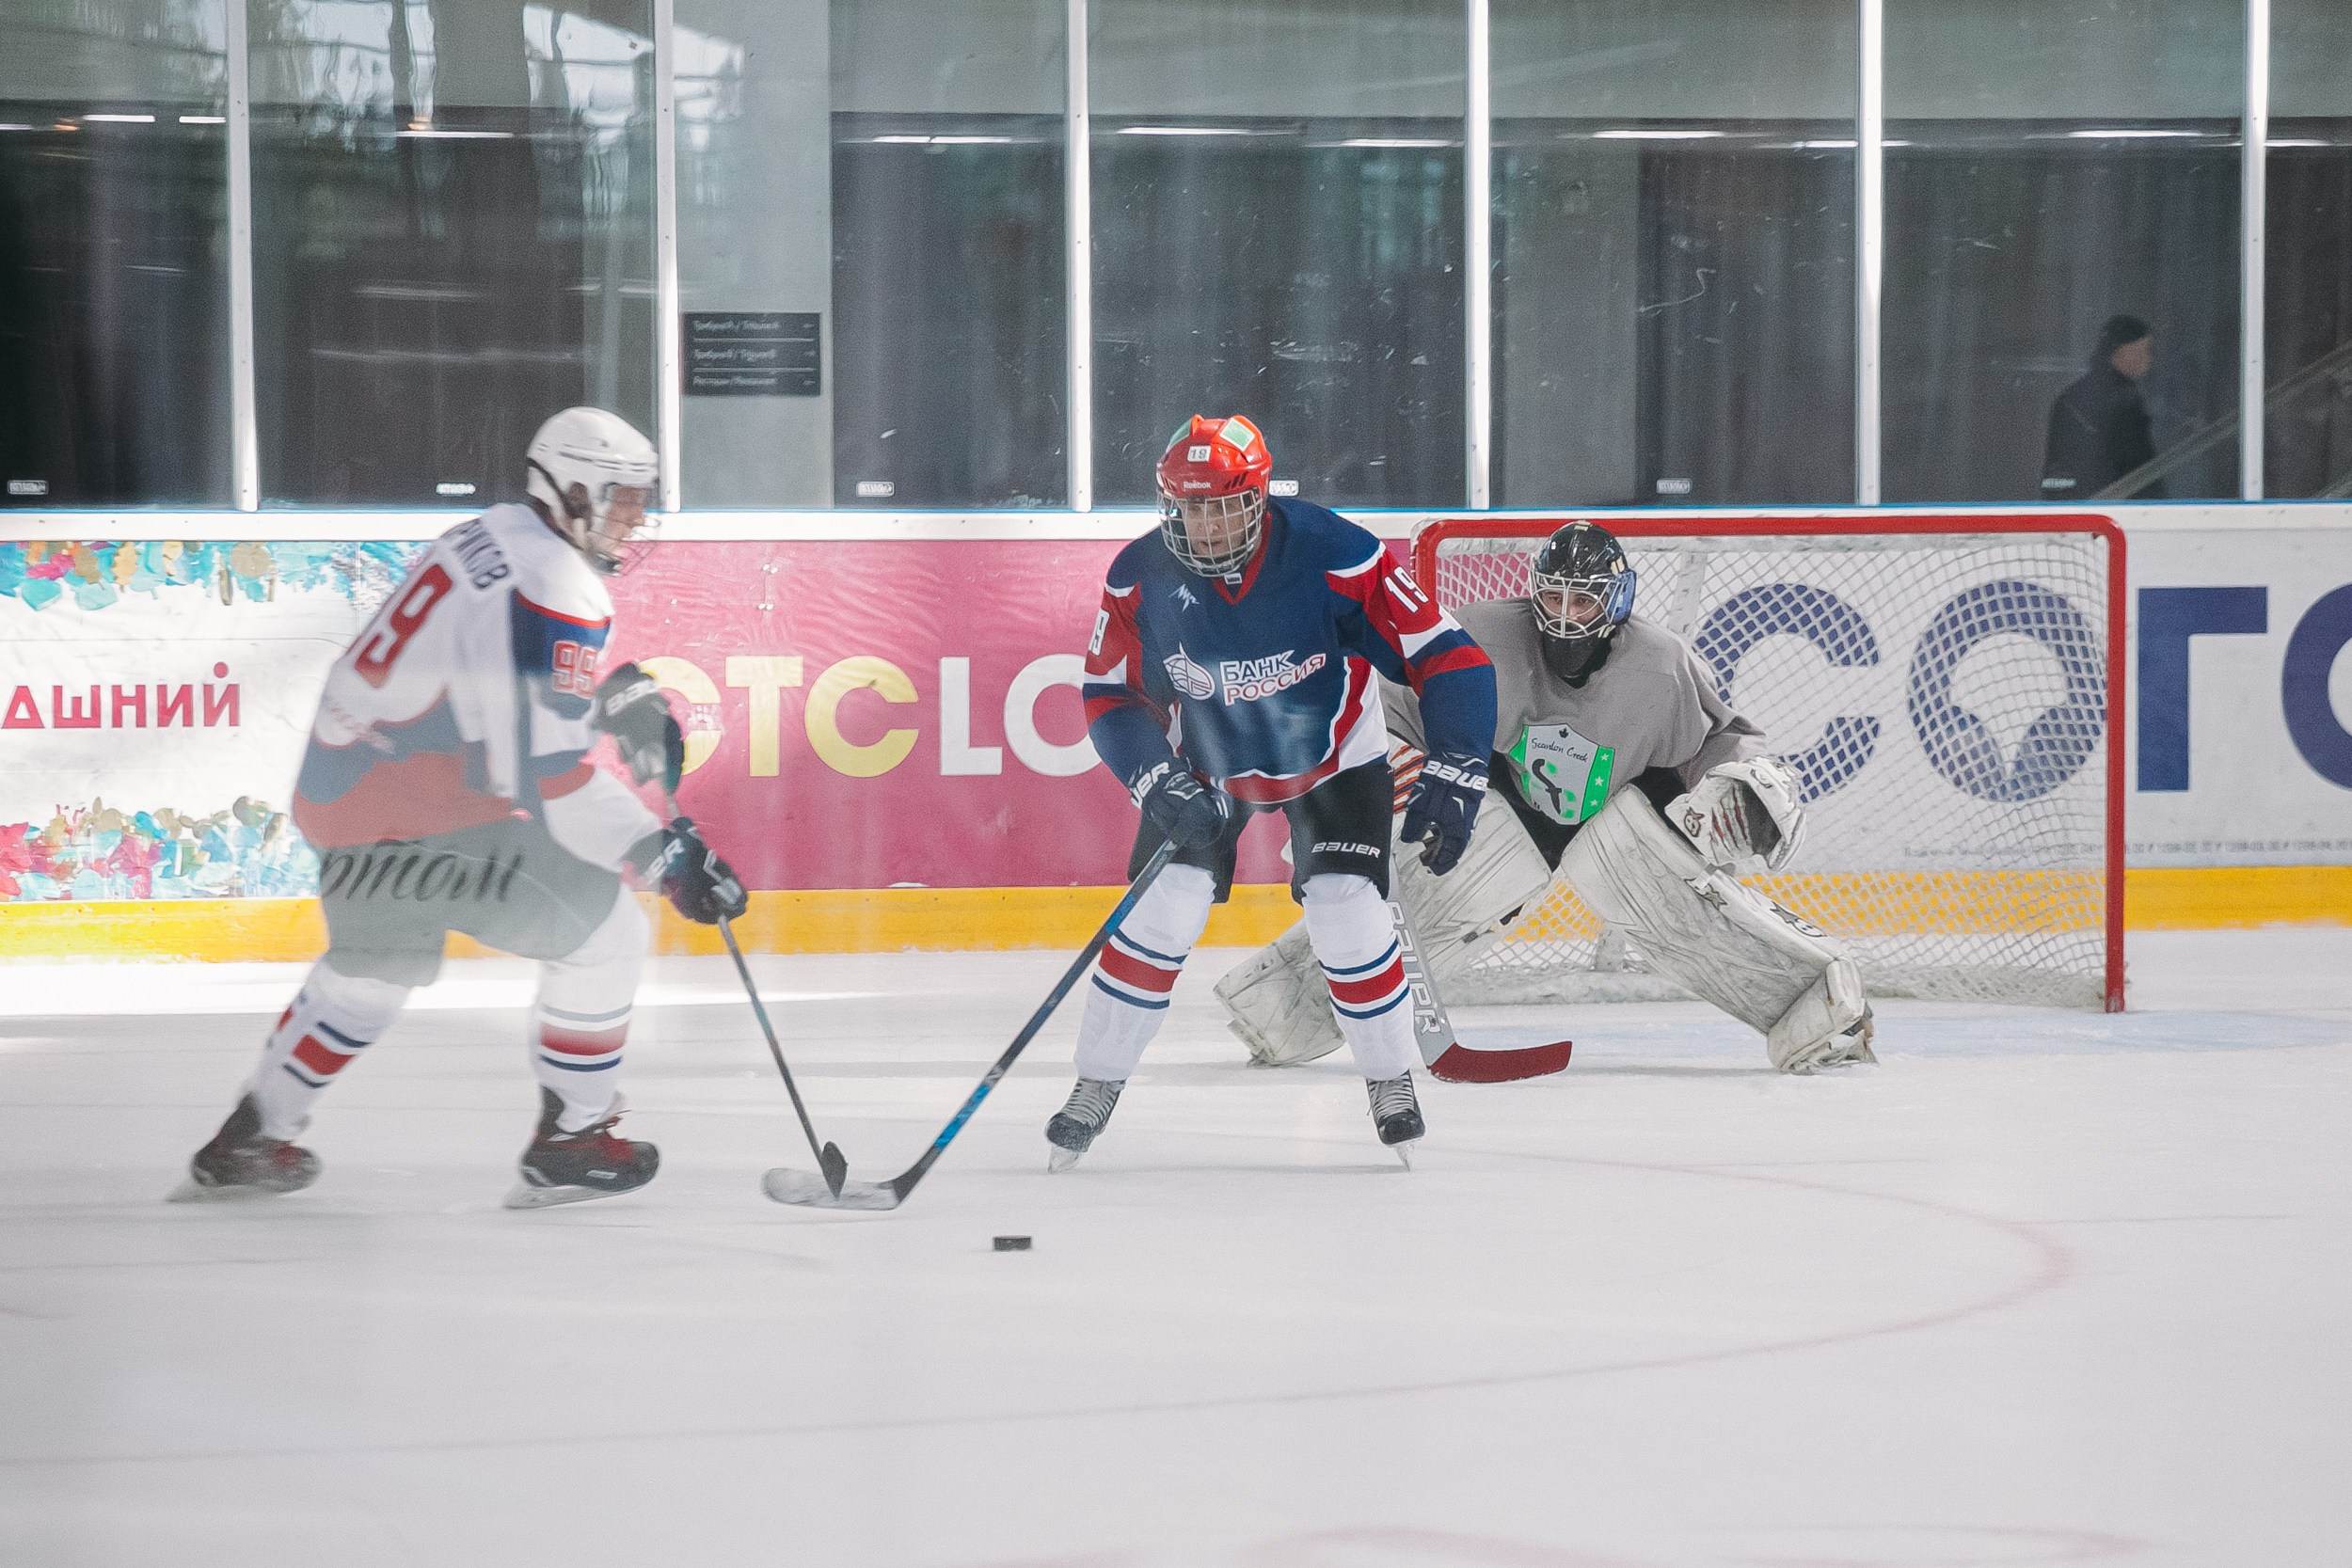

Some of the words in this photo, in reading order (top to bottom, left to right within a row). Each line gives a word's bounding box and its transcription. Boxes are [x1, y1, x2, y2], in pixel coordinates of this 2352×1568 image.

[1191, 448, 1207, 460] 19
[1184, 481, 1212, 489] Reebok
[1385, 566, 1429, 613] 19
[1220, 649, 1295, 686] БАНК
[1223, 653, 1327, 706] РОССИЯ
[1311, 842, 1380, 859] BAUER
